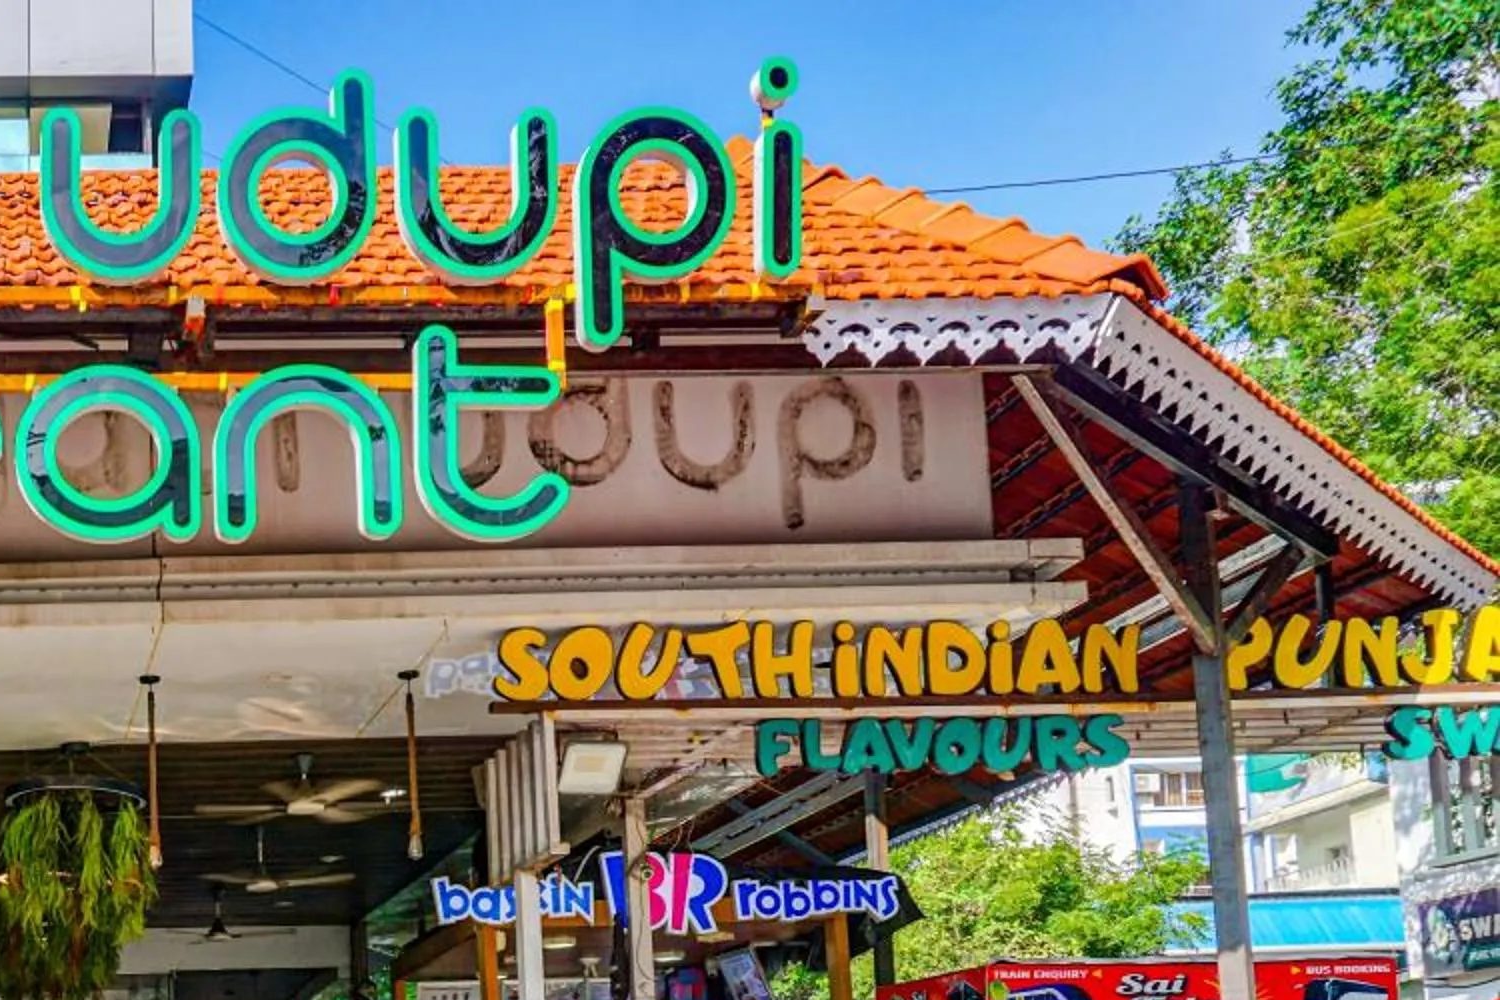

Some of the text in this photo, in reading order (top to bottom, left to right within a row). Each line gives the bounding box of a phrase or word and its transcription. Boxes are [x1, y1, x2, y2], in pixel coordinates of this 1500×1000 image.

[756, 713, 1132, 777] FLAVOURS
[995, 969, 1089, 979] TRAIN ENQUIRY
[1306, 966, 1331, 975] BUS
[1116, 973, 1186, 995] Sai
